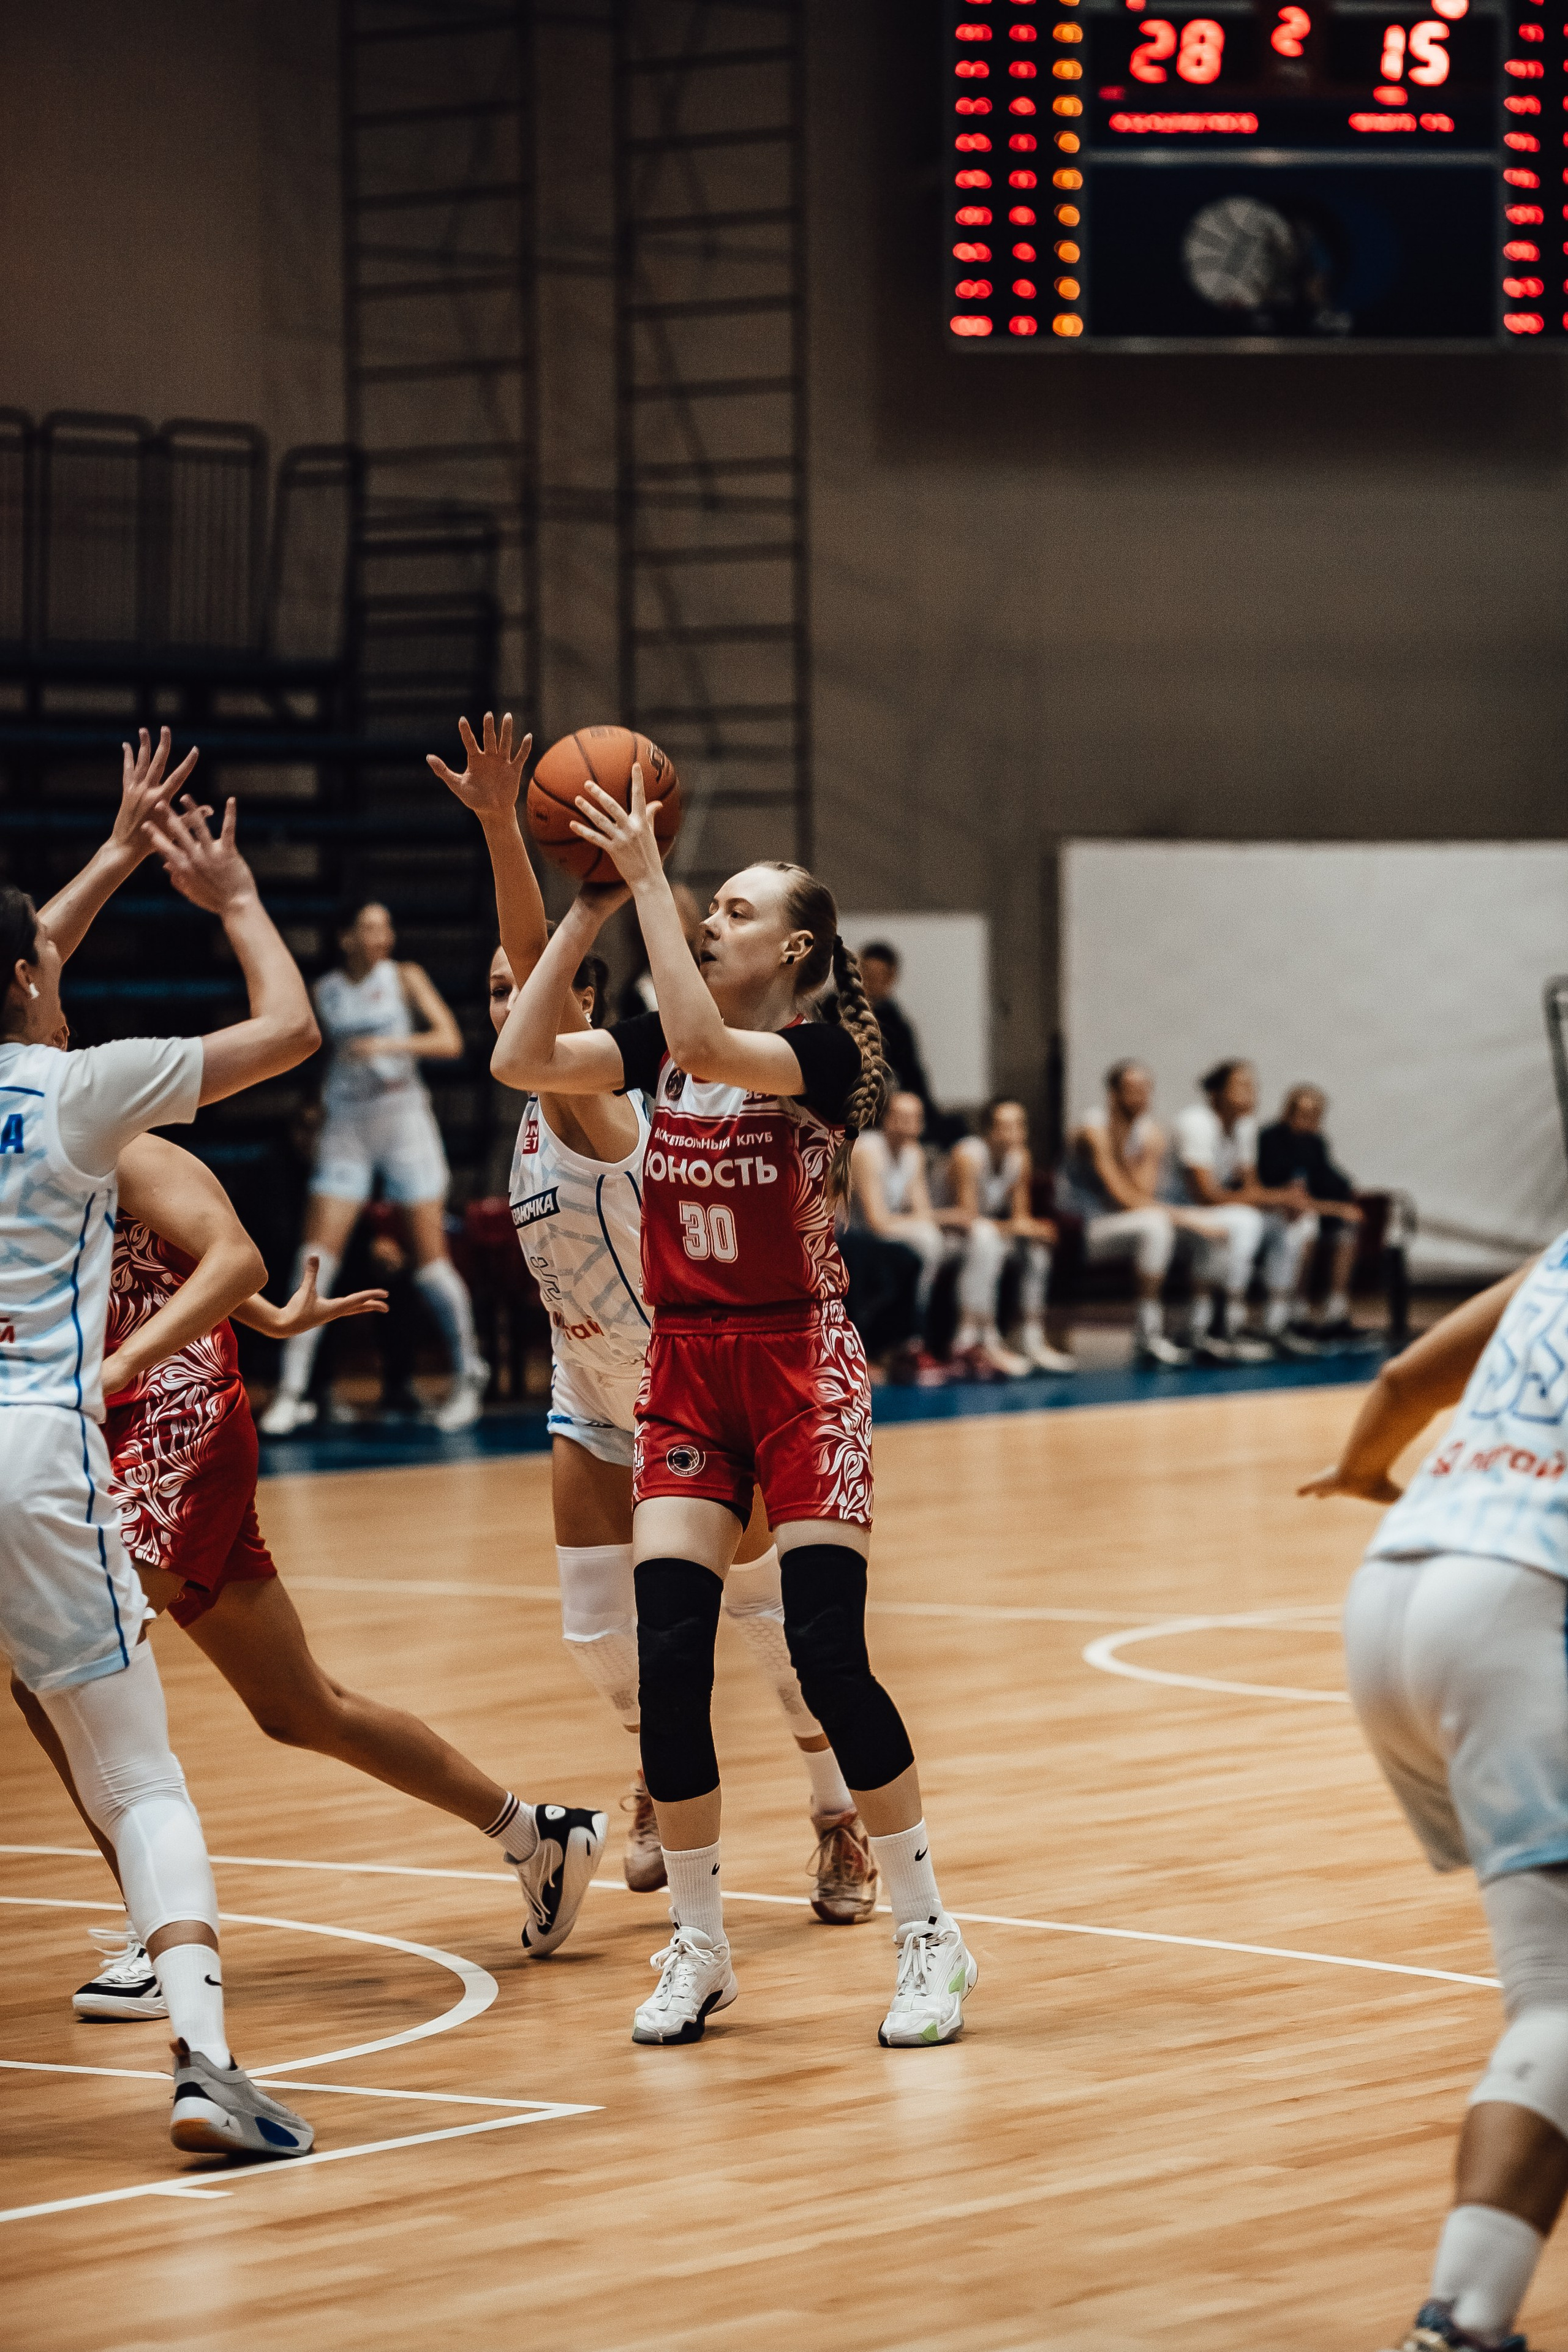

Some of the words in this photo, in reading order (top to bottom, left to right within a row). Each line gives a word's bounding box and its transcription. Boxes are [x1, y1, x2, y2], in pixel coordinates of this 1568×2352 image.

[1129, 18, 1225, 85] 28
[1271, 6, 1311, 57] 2
[1380, 20, 1450, 86] 15
[736, 1131, 773, 1146] КЛУБ
[644, 1149, 778, 1188] ЮНОСТЬ
[679, 1200, 739, 1264] 30
